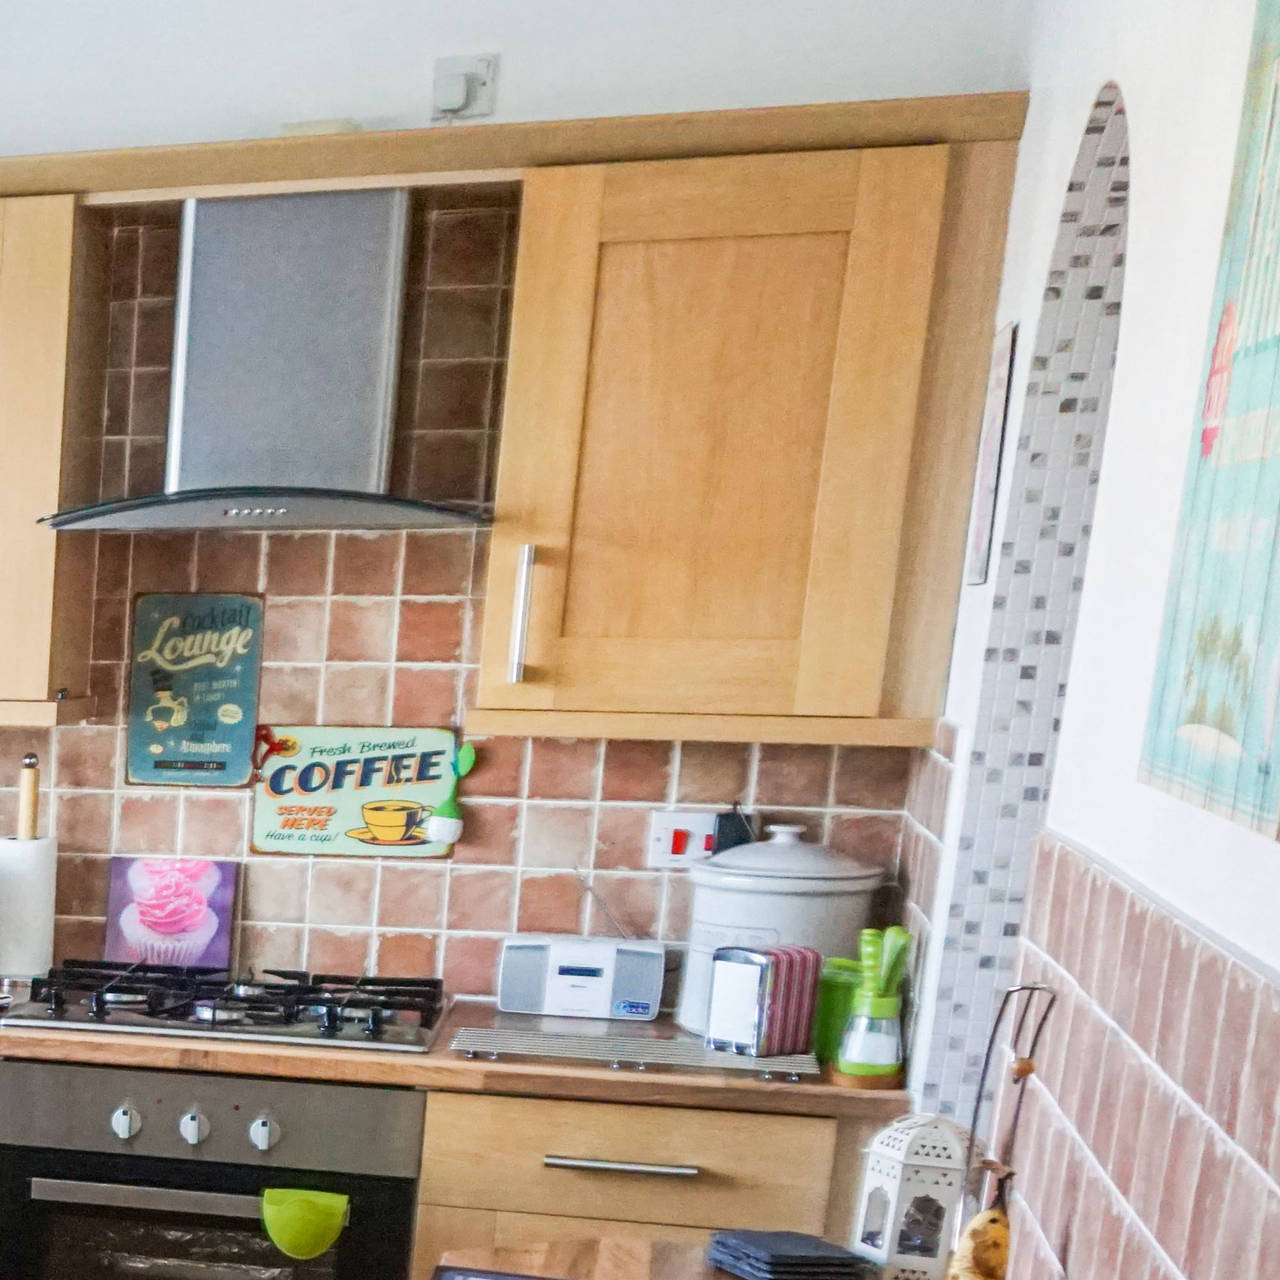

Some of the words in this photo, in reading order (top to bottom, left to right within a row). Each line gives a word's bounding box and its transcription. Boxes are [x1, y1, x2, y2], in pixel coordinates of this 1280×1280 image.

[137, 616, 254, 671] Lounge
[310, 742, 352, 757] Fresh
[359, 736, 417, 754] Brewed
[266, 749, 447, 797] COFFEE
[275, 805, 337, 817] SERVED
[280, 816, 331, 830] HERE
[264, 830, 294, 841] Have
